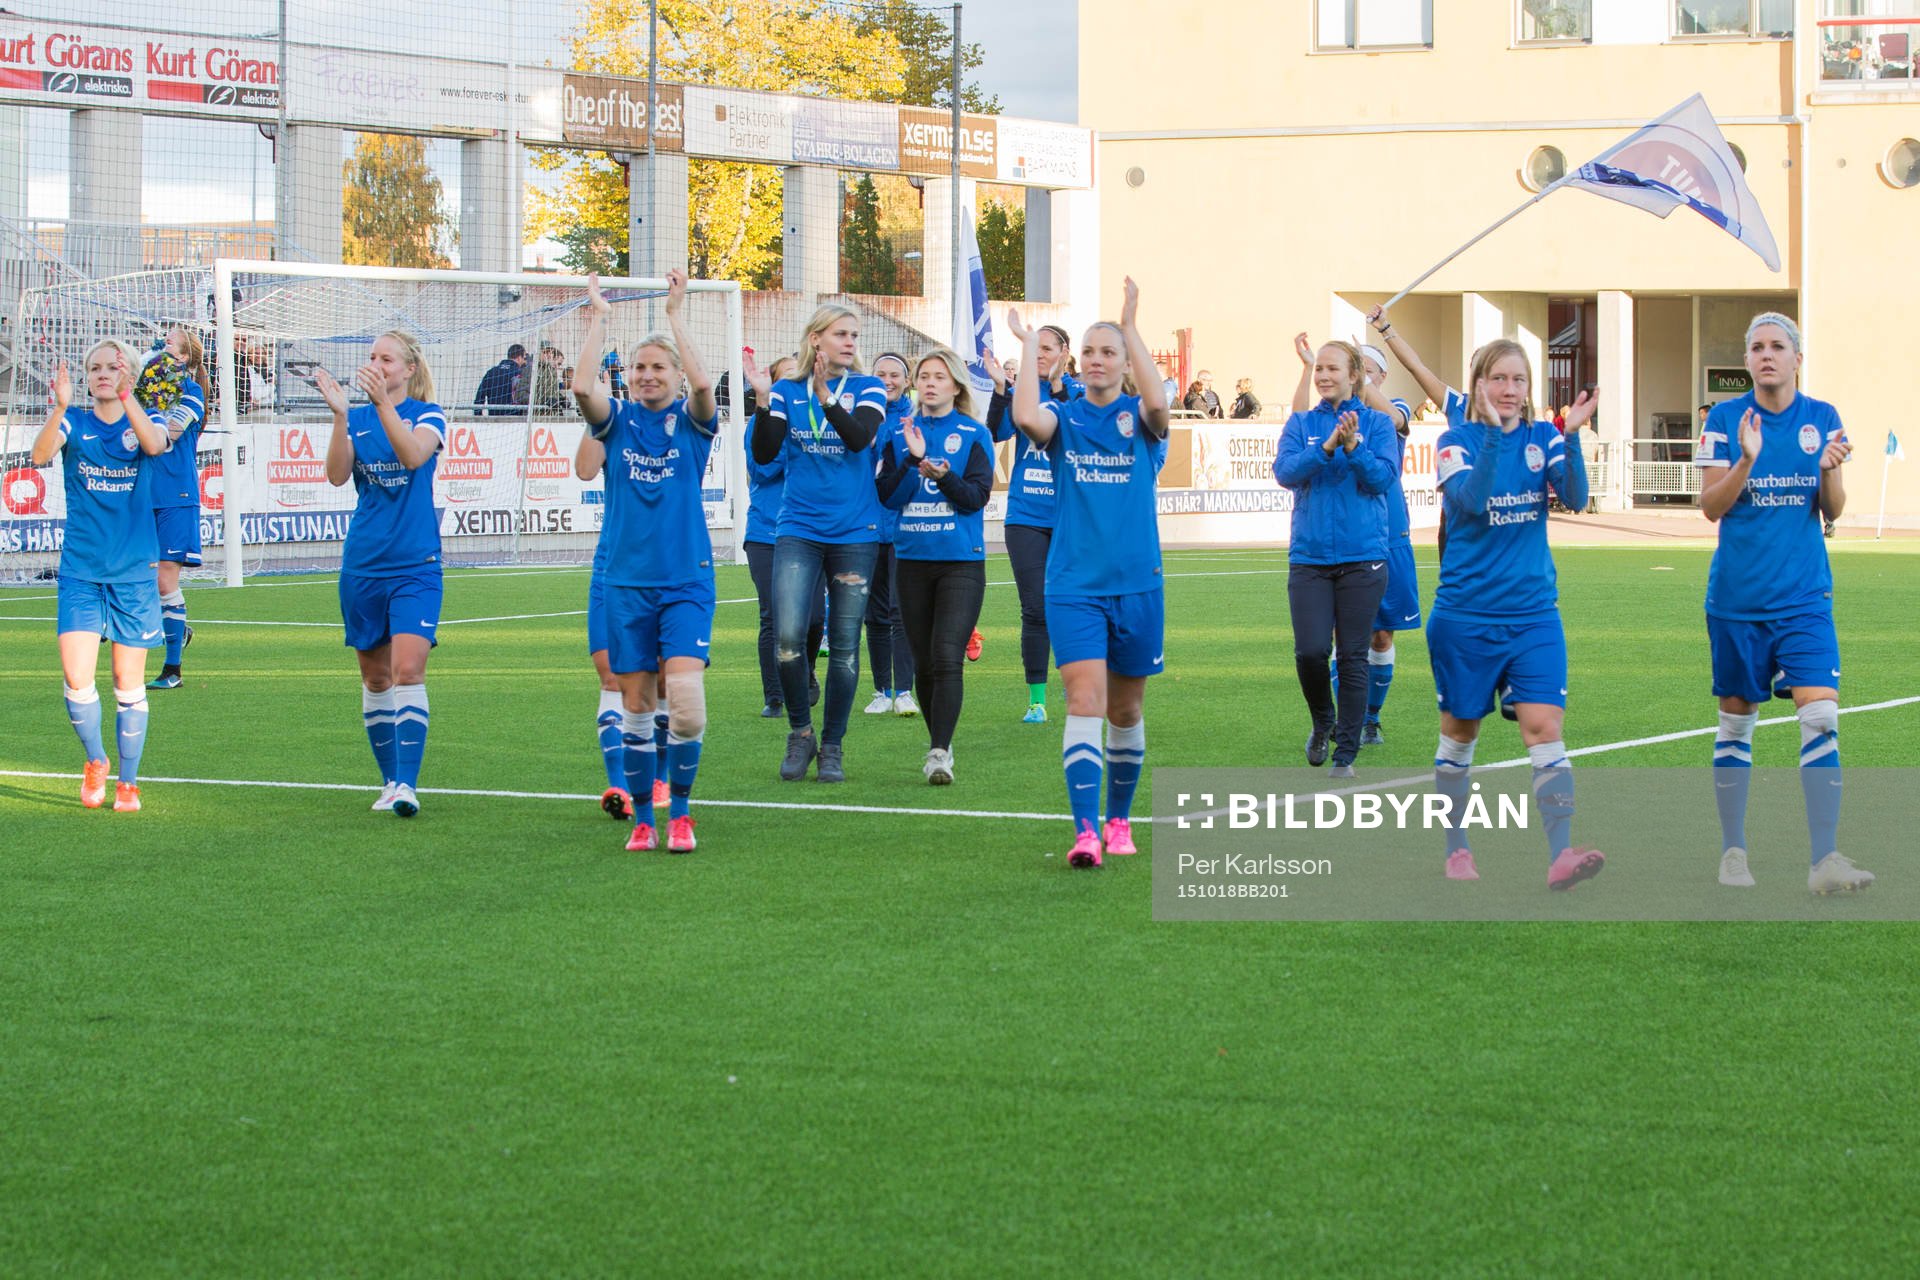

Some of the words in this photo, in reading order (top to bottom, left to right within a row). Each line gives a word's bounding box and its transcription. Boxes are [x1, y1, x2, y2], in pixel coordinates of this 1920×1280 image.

[44, 33, 133, 72] Görans
[146, 41, 197, 78] Kurt
[564, 84, 596, 125] One
[597, 88, 617, 126] of
[618, 90, 647, 129] the
[729, 104, 786, 129] Elektronik
[729, 127, 771, 150] Partner
[279, 429, 315, 459] ICA
[448, 428, 481, 457] ICA
[527, 427, 559, 456] ICA
[270, 464, 325, 479] KVANTUM
[356, 459, 407, 475] Sparban
[440, 462, 491, 475] KVANTUM
[1075, 467, 1131, 484] Rekarne
[86, 477, 134, 493] Rekarne
[1751, 491, 1806, 508] Rekarne
[943, 521, 956, 531] AB
